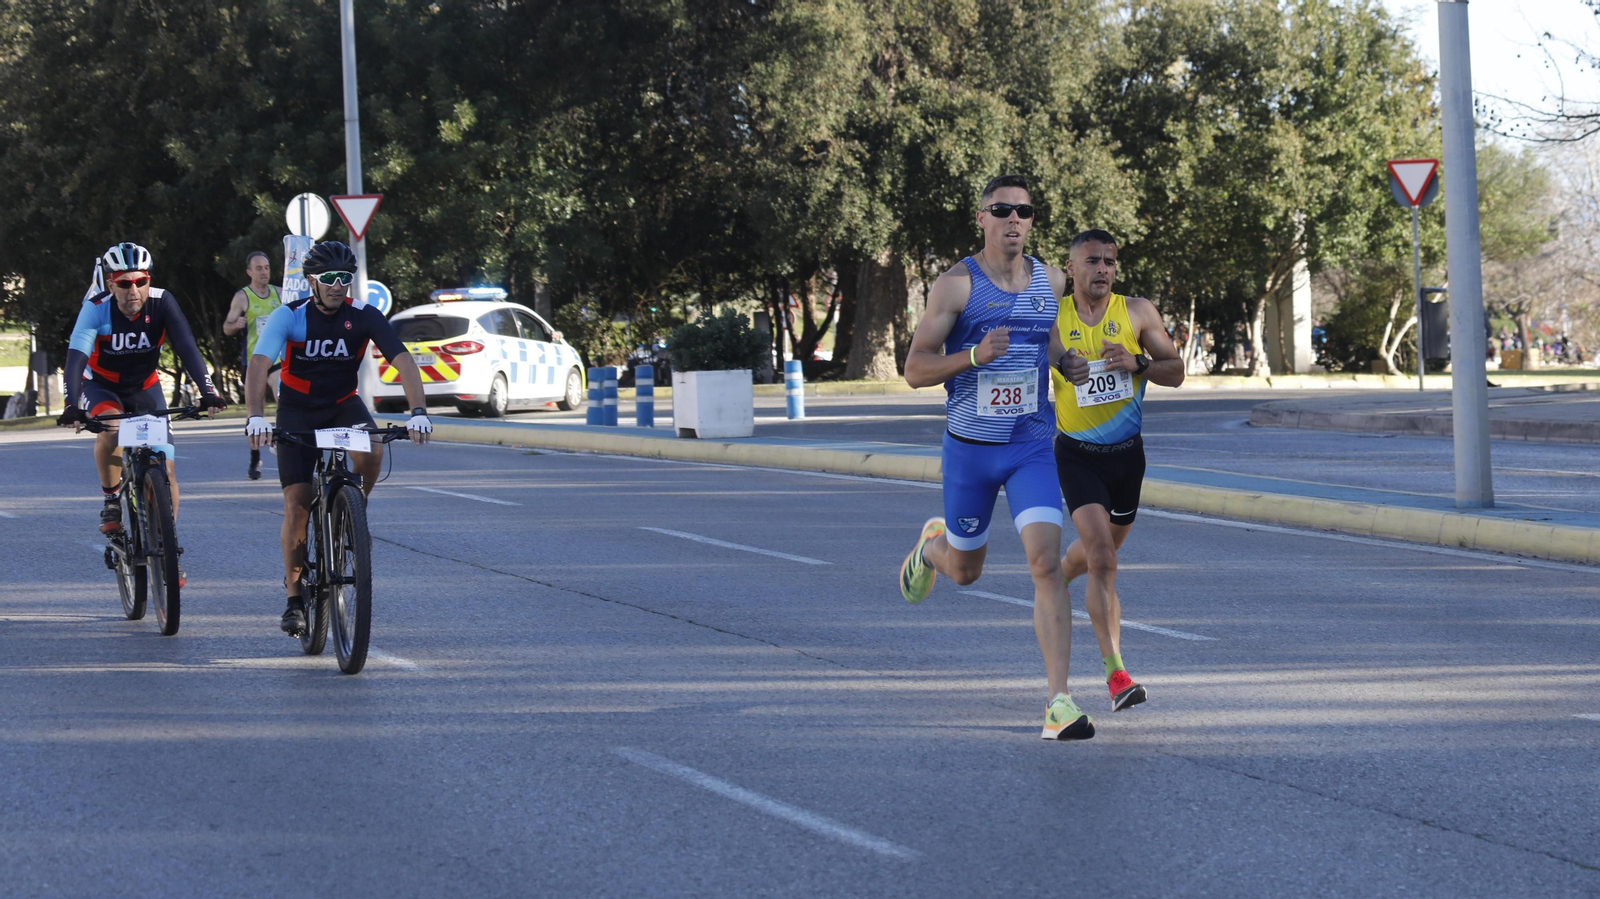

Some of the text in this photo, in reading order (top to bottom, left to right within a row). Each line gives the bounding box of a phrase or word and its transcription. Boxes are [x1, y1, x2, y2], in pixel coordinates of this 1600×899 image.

[111, 331, 152, 351] UCA
[305, 338, 349, 357] UCA
[1087, 374, 1116, 395] 209
[990, 387, 1022, 406] 238
[1093, 392, 1121, 403] EVOS
[994, 407, 1024, 415] EVOS
[1079, 439, 1134, 453] NIKE PRO
